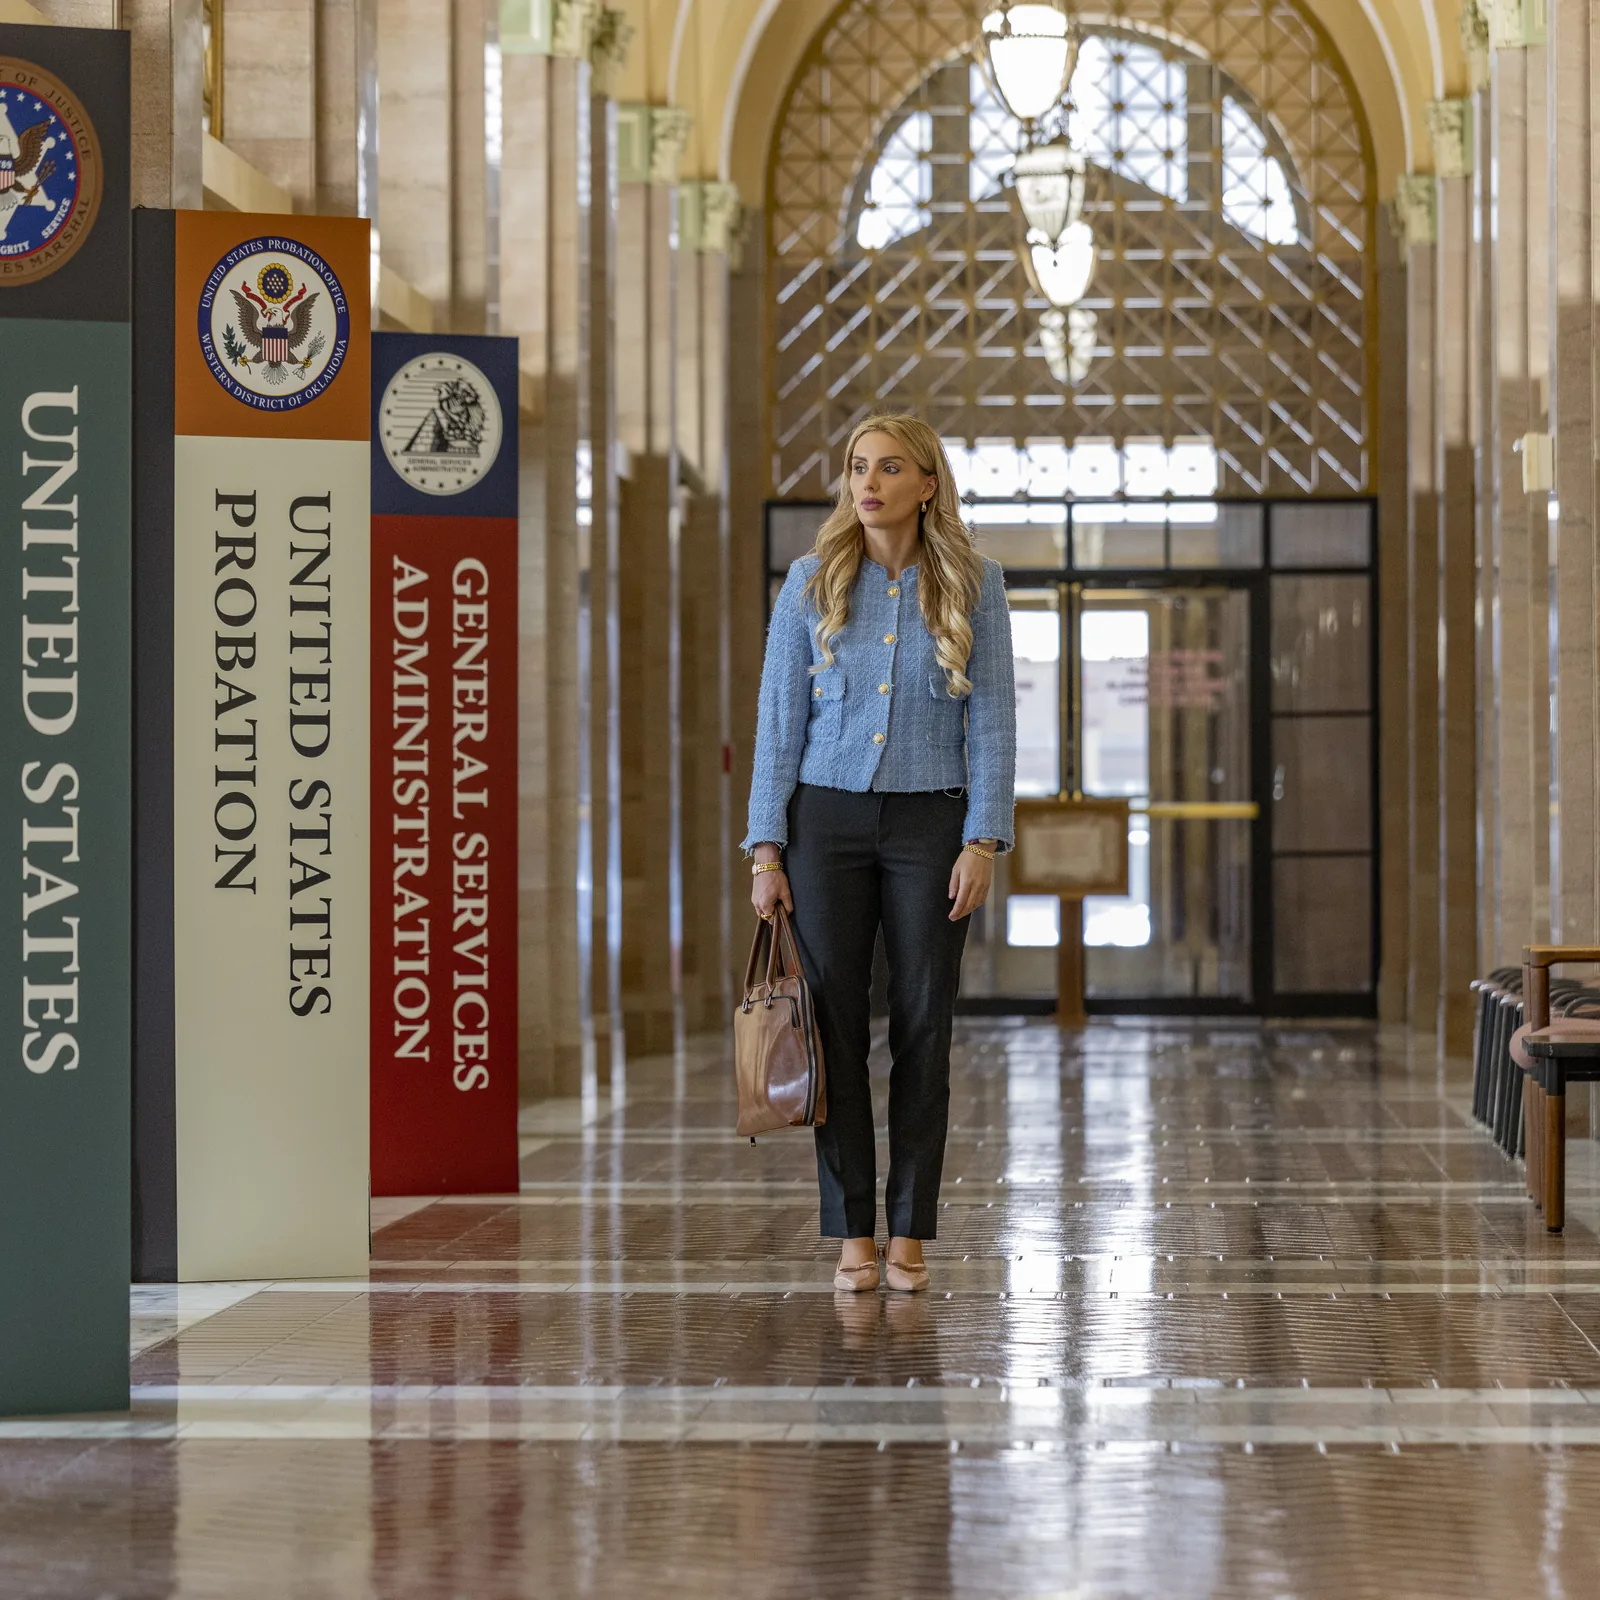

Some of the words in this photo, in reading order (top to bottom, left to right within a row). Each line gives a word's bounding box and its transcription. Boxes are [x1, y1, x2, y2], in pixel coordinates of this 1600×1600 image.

[0, 160, 13, 170] 89
[0, 260, 25, 274] ES
[29, 199, 89, 268] MARSHAL
[15, 72, 39, 87] OF
[45, 90, 92, 160] JUSTICE
[41, 197, 72, 239] SERVICE
[201, 264, 226, 308] UNITED
[226, 240, 264, 266] STATES
[268, 239, 326, 273] PROBATION
[324, 271, 346, 314] OFFICE
[201, 333, 234, 389] WESTERN
[234, 386, 285, 410] DISTRICT
[288, 394, 303, 407] OF
[305, 339, 347, 400] OKLAHOMA
[22, 385, 79, 735] UNITED
[289, 491, 332, 758] UNITED
[214, 488, 257, 895] PROBATION
[393, 555, 429, 1062] ADMINISTRATION
[453, 558, 488, 818] GENERAL
[22, 762, 79, 1074] STATES
[289, 779, 332, 1016] STATES
[453, 833, 488, 1091] SERVICES
